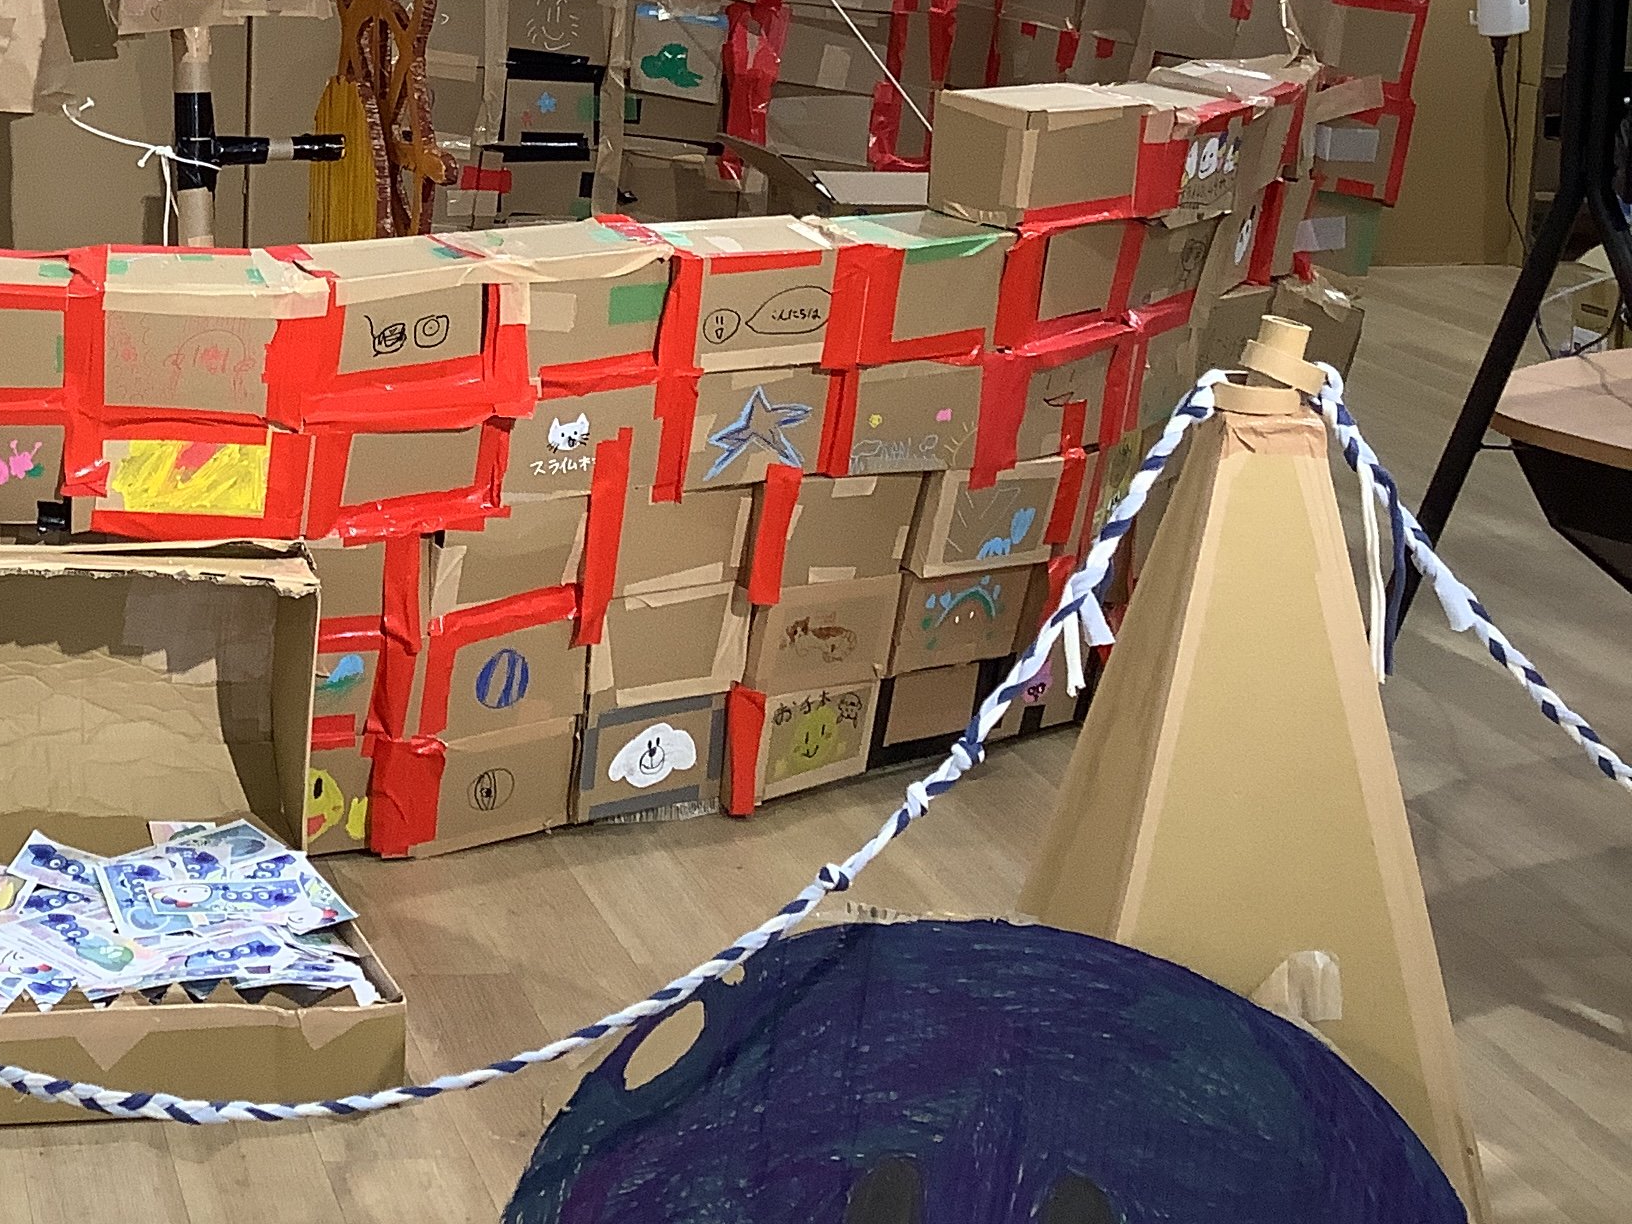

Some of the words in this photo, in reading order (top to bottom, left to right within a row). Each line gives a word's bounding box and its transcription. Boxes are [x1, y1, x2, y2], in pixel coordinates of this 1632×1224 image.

[770, 308, 821, 322] こんにちは
